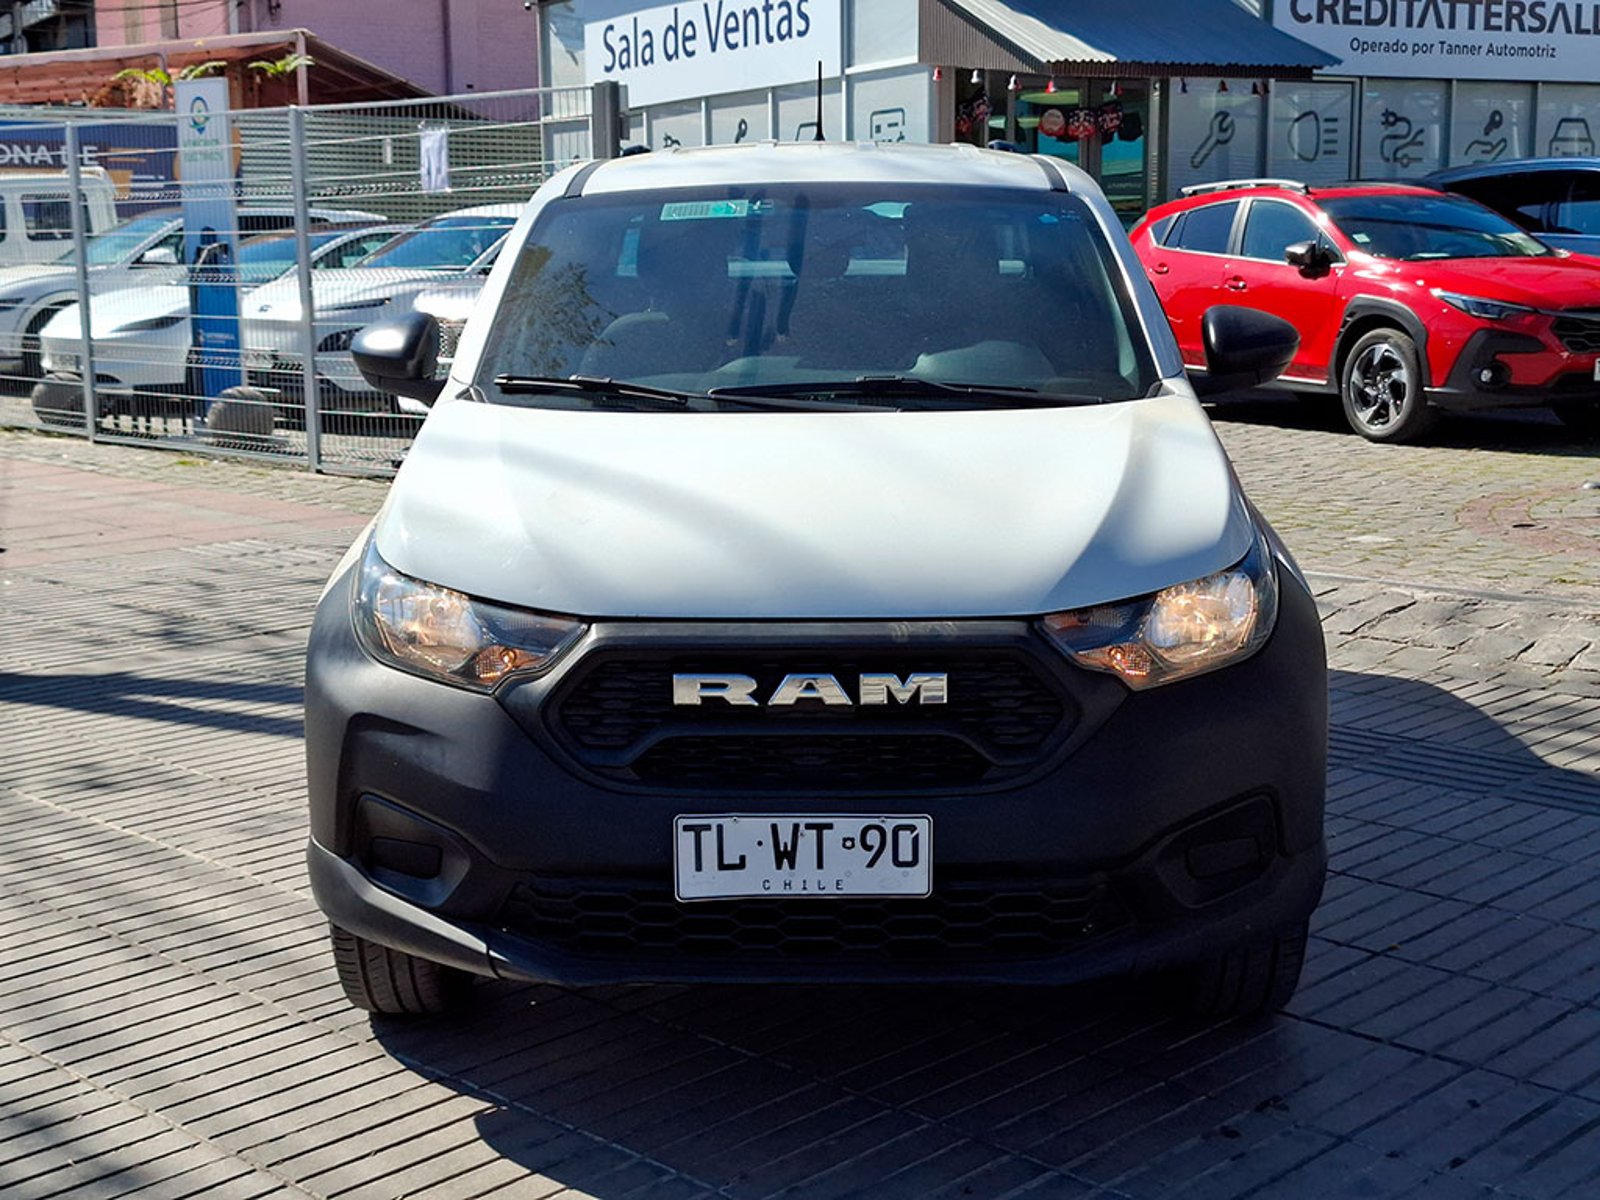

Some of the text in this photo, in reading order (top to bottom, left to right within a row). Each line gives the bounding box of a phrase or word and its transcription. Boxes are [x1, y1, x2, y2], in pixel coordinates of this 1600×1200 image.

[602, 0, 811, 73] Sala de Ventas
[1349, 37, 1557, 58] Operado por Tanner Automotriz
[672, 672, 948, 706] RAM
[762, 878, 844, 891] CHILE
